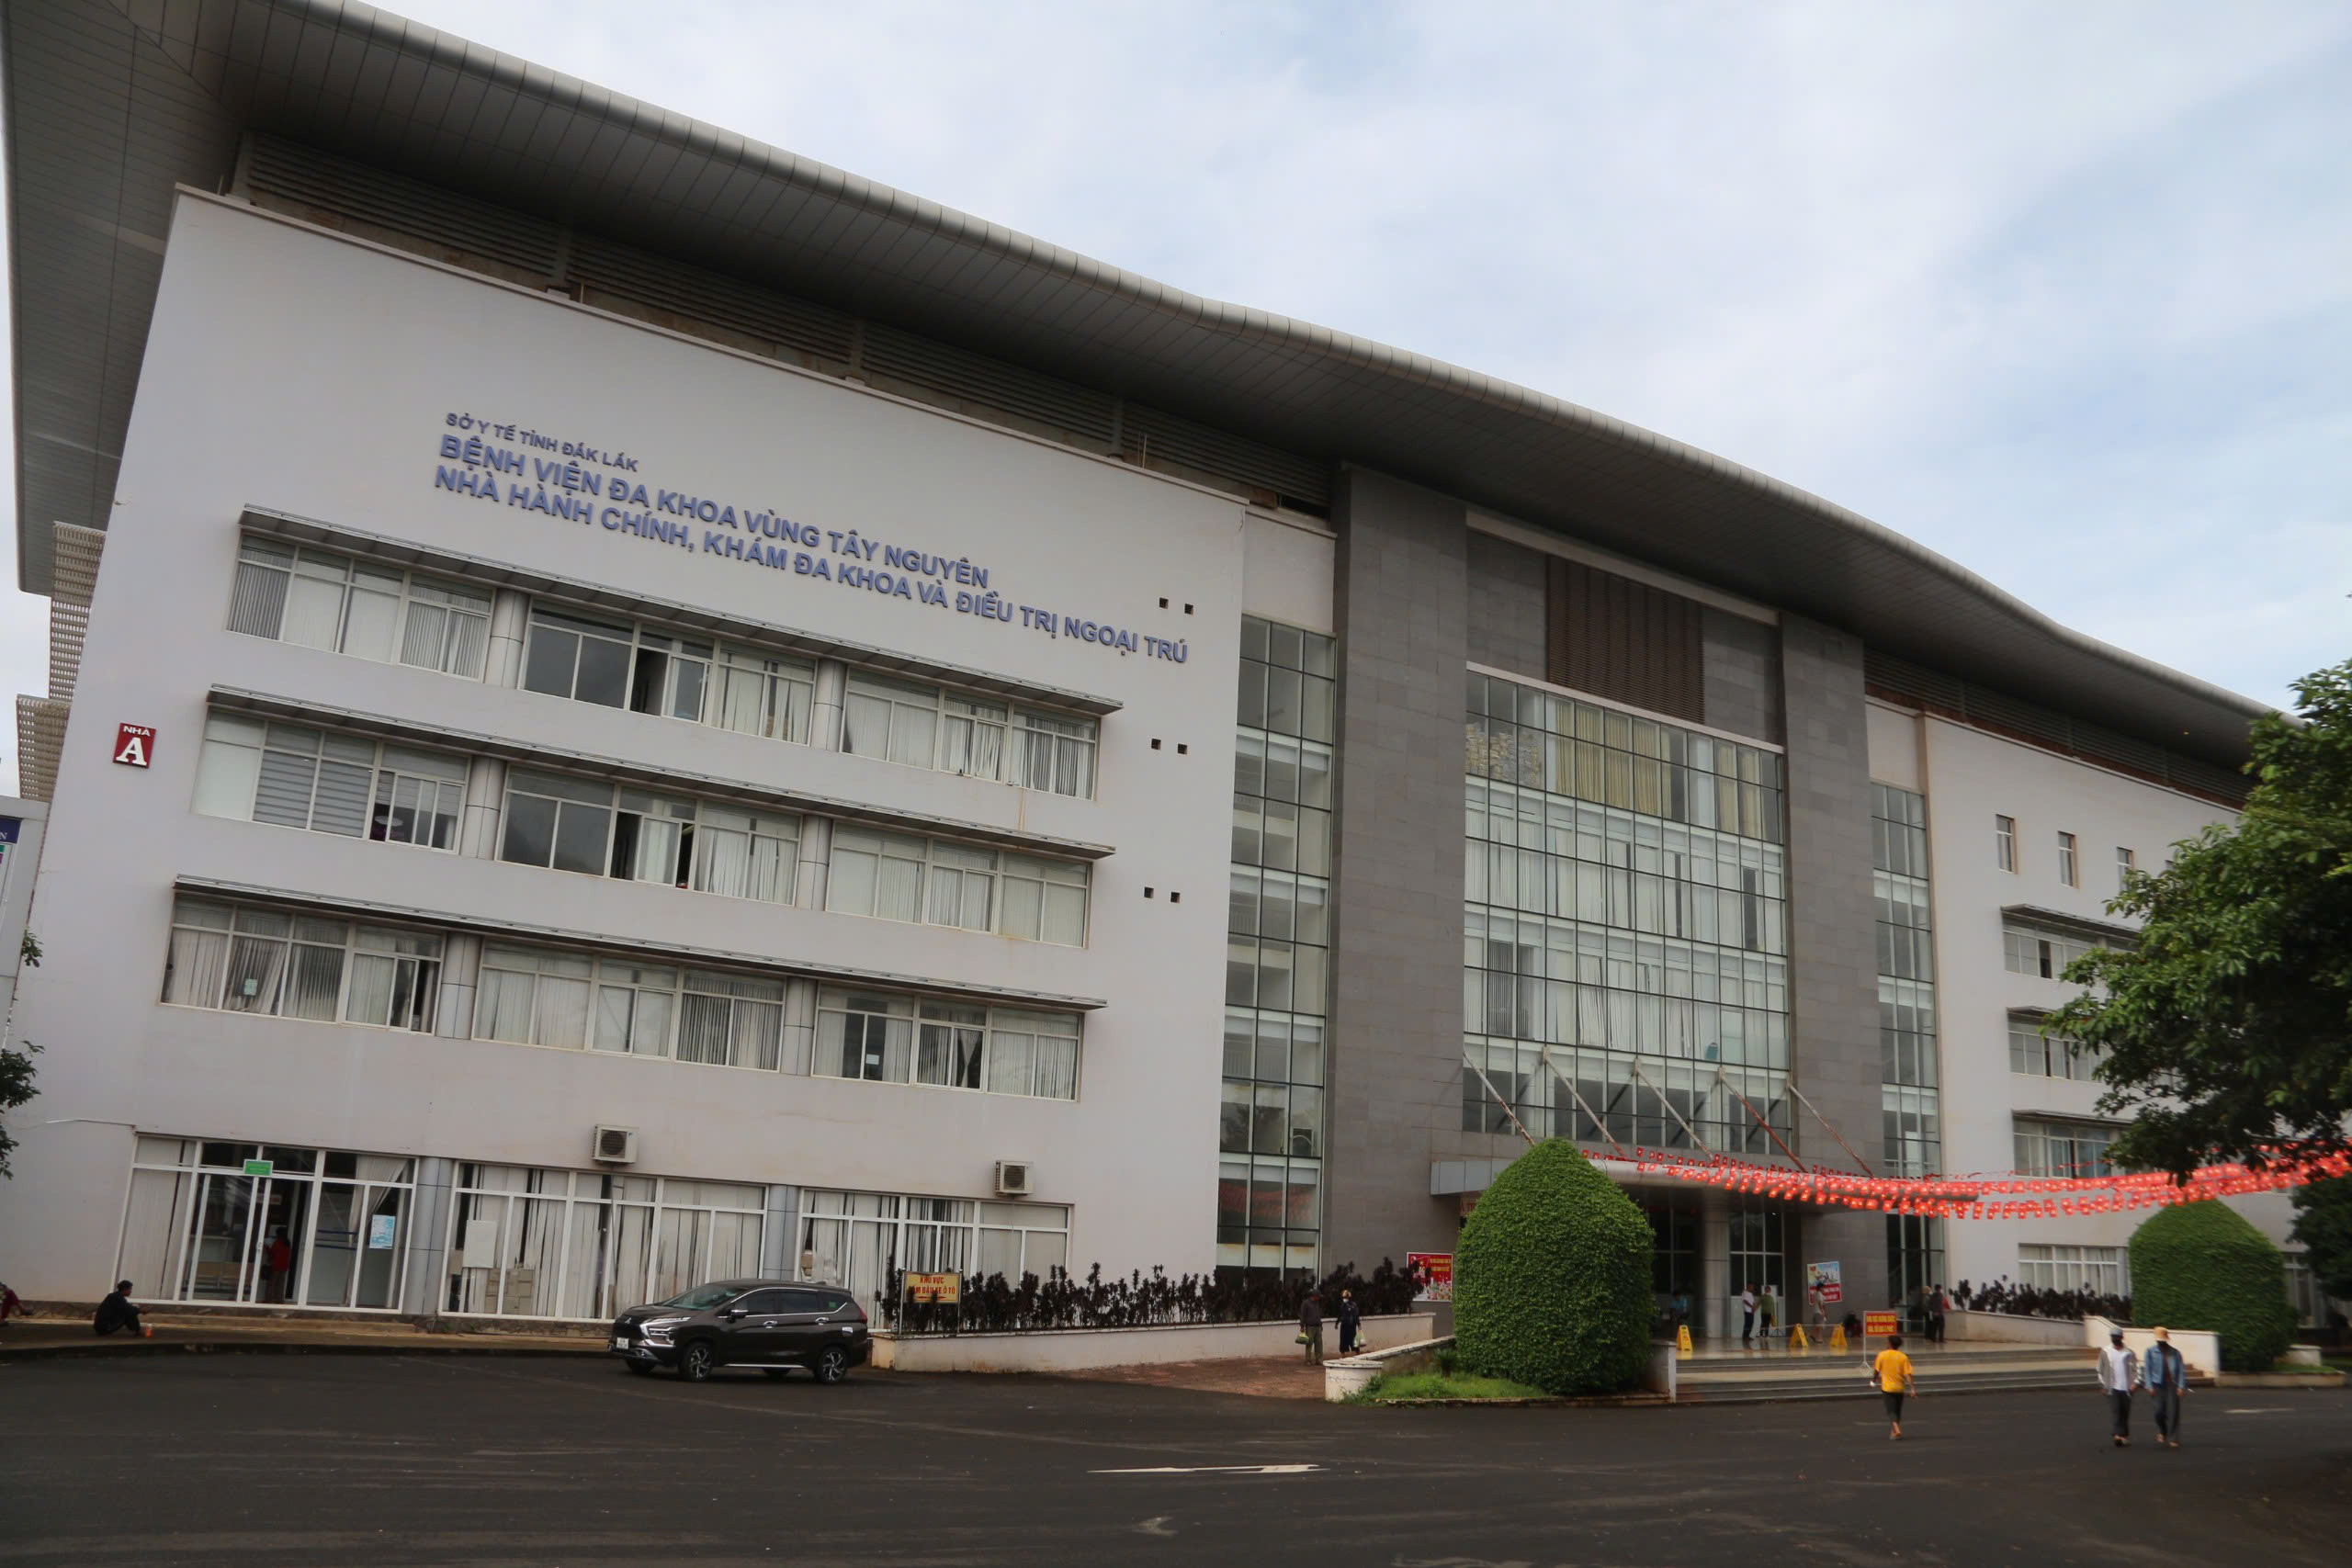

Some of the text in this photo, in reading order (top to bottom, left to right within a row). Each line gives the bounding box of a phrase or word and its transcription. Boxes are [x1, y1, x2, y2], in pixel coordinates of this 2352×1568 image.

[478, 420, 491, 434] Y
[493, 424, 516, 441] TẾ
[440, 434, 989, 590] BỆNH VIỆN ĐA KHOA VÙNG TÂY NGUYÊN
[435, 466, 1187, 664] NHÀ HÀNH CHÍNH, KHÁM ĐA KHOA VÀ ĐIỀU TRỊ NGOẠI TRÚ
[116, 737, 147, 765] A
